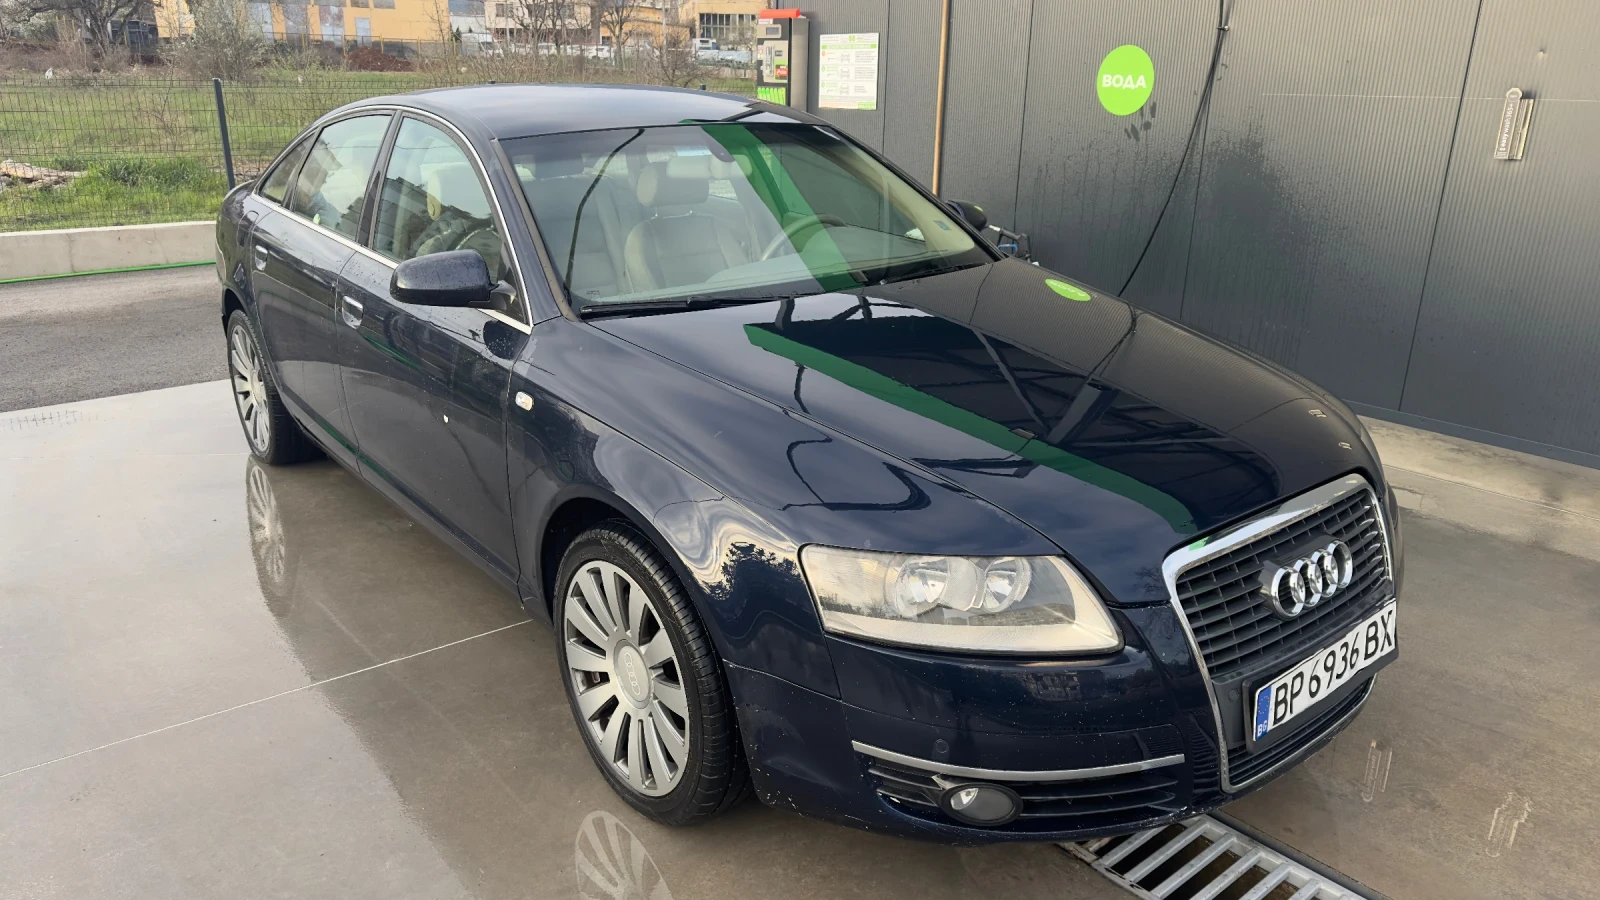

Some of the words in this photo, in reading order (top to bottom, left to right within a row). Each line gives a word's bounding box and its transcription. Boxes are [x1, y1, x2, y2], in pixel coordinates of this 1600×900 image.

[1102, 74, 1147, 90] ВОДА
[1273, 671, 1304, 726] BP
[1308, 632, 1360, 698] 6936
[1364, 610, 1393, 661] BX
[1257, 720, 1268, 736] BG
